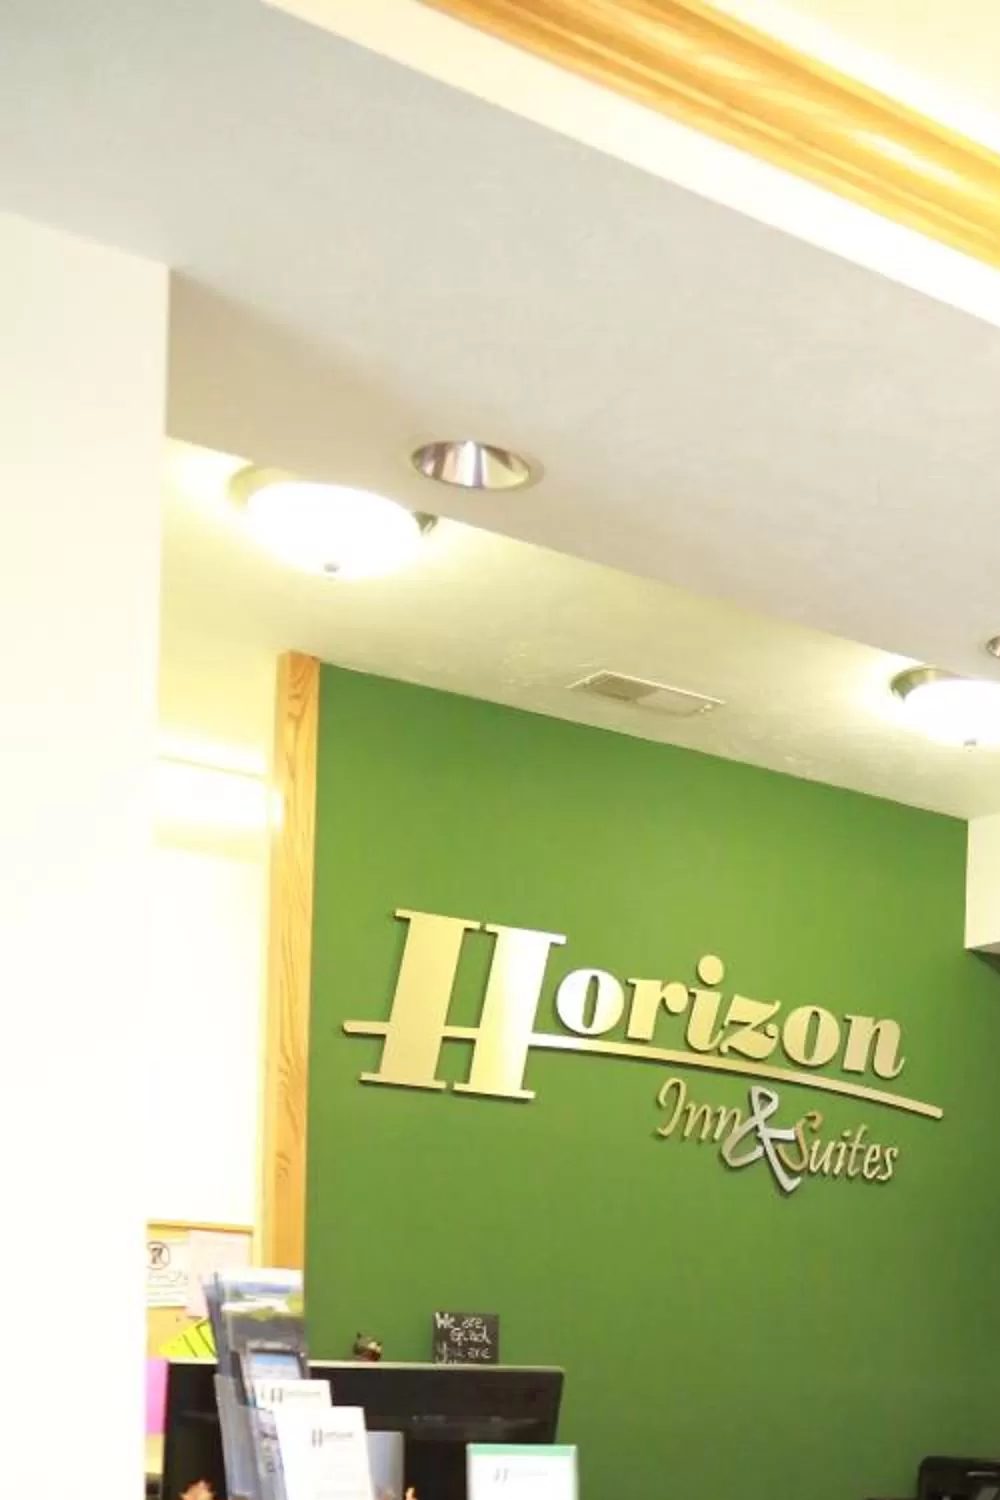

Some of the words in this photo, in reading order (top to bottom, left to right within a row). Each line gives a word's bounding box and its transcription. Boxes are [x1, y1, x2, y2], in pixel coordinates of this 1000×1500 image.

[343, 908, 906, 1100] Horizon
[656, 1077, 742, 1142] Inn
[721, 1085, 802, 1193] &
[776, 1110, 899, 1181] Suites
[435, 1311, 456, 1329] We
